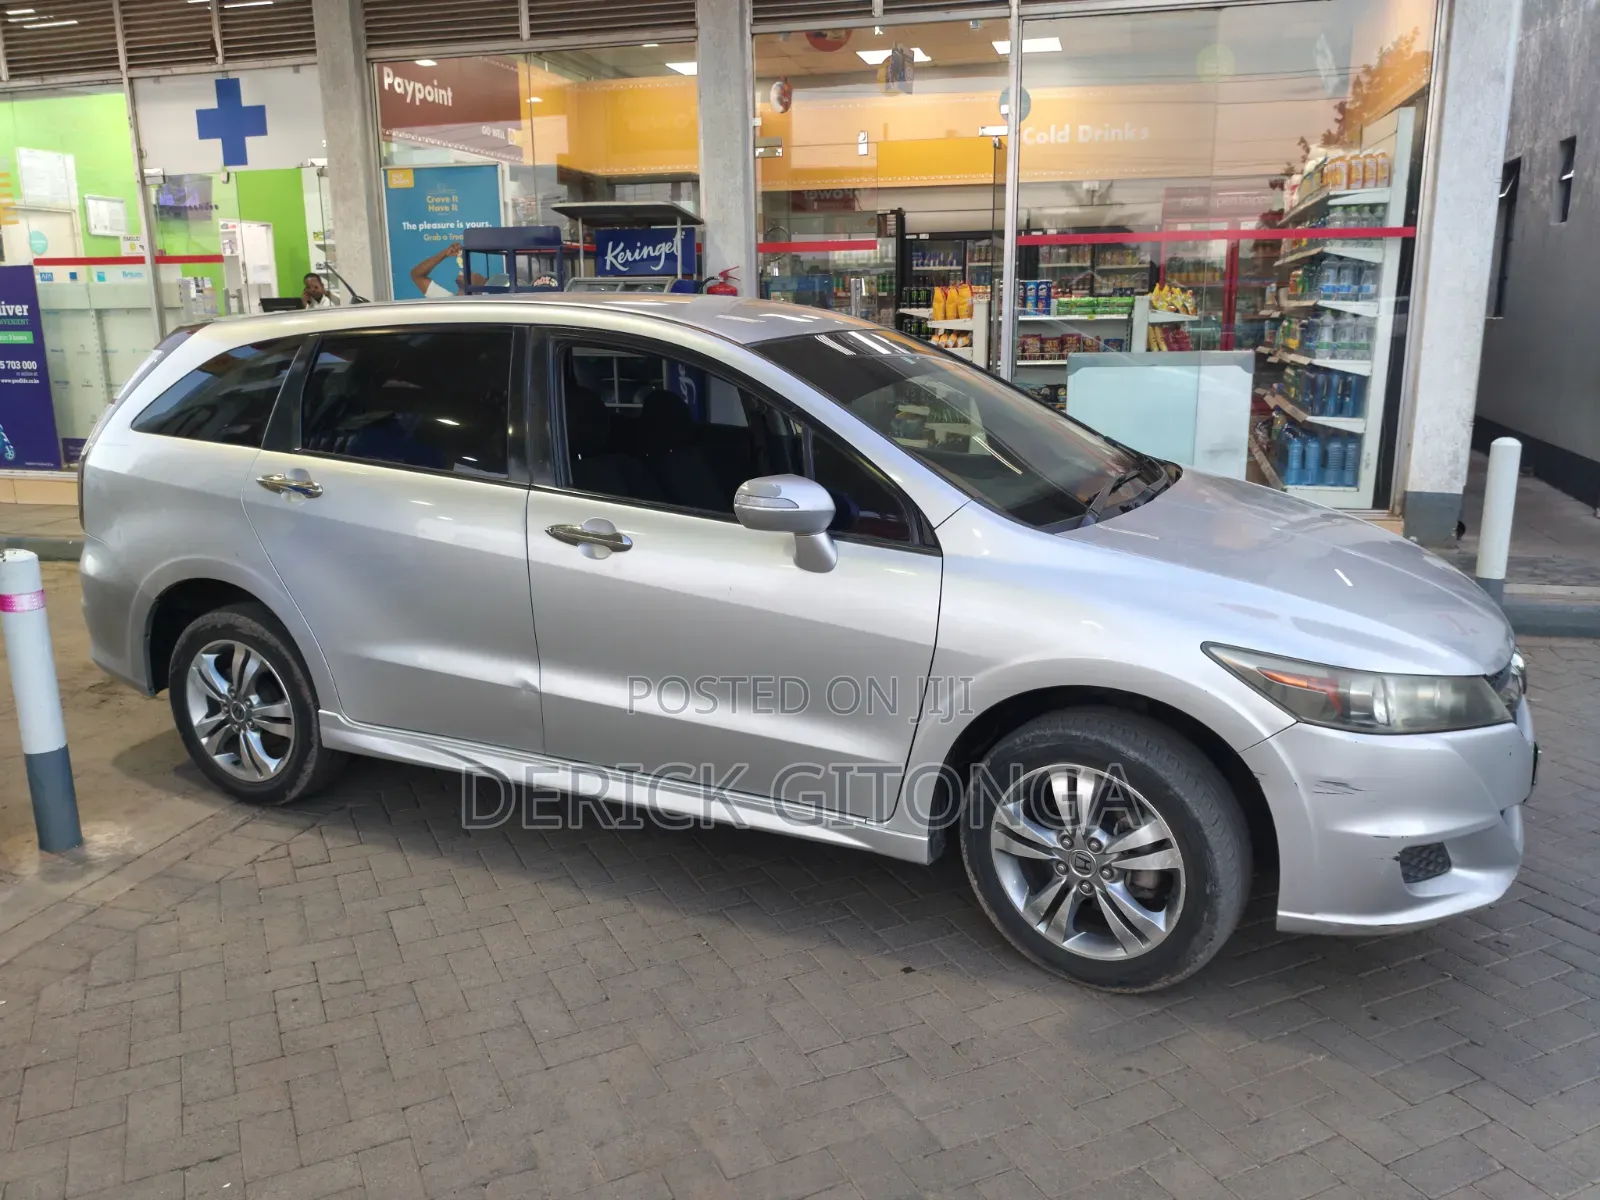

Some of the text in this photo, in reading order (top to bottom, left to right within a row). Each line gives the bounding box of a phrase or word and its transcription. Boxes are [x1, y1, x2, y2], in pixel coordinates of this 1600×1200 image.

[383, 66, 453, 107] Paypoint
[481, 125, 506, 141] GO WELL
[1022, 121, 1150, 145] Cold Drinks
[426, 195, 451, 204] Crave
[428, 204, 450, 212] Have
[402, 220, 493, 232] The pleasure is yours.
[423, 232, 442, 242] Grab
[449, 232, 464, 241] Trea
[604, 231, 680, 271] Keringet
[6, 360, 21, 370] 703
[22, 360, 38, 370] 000
